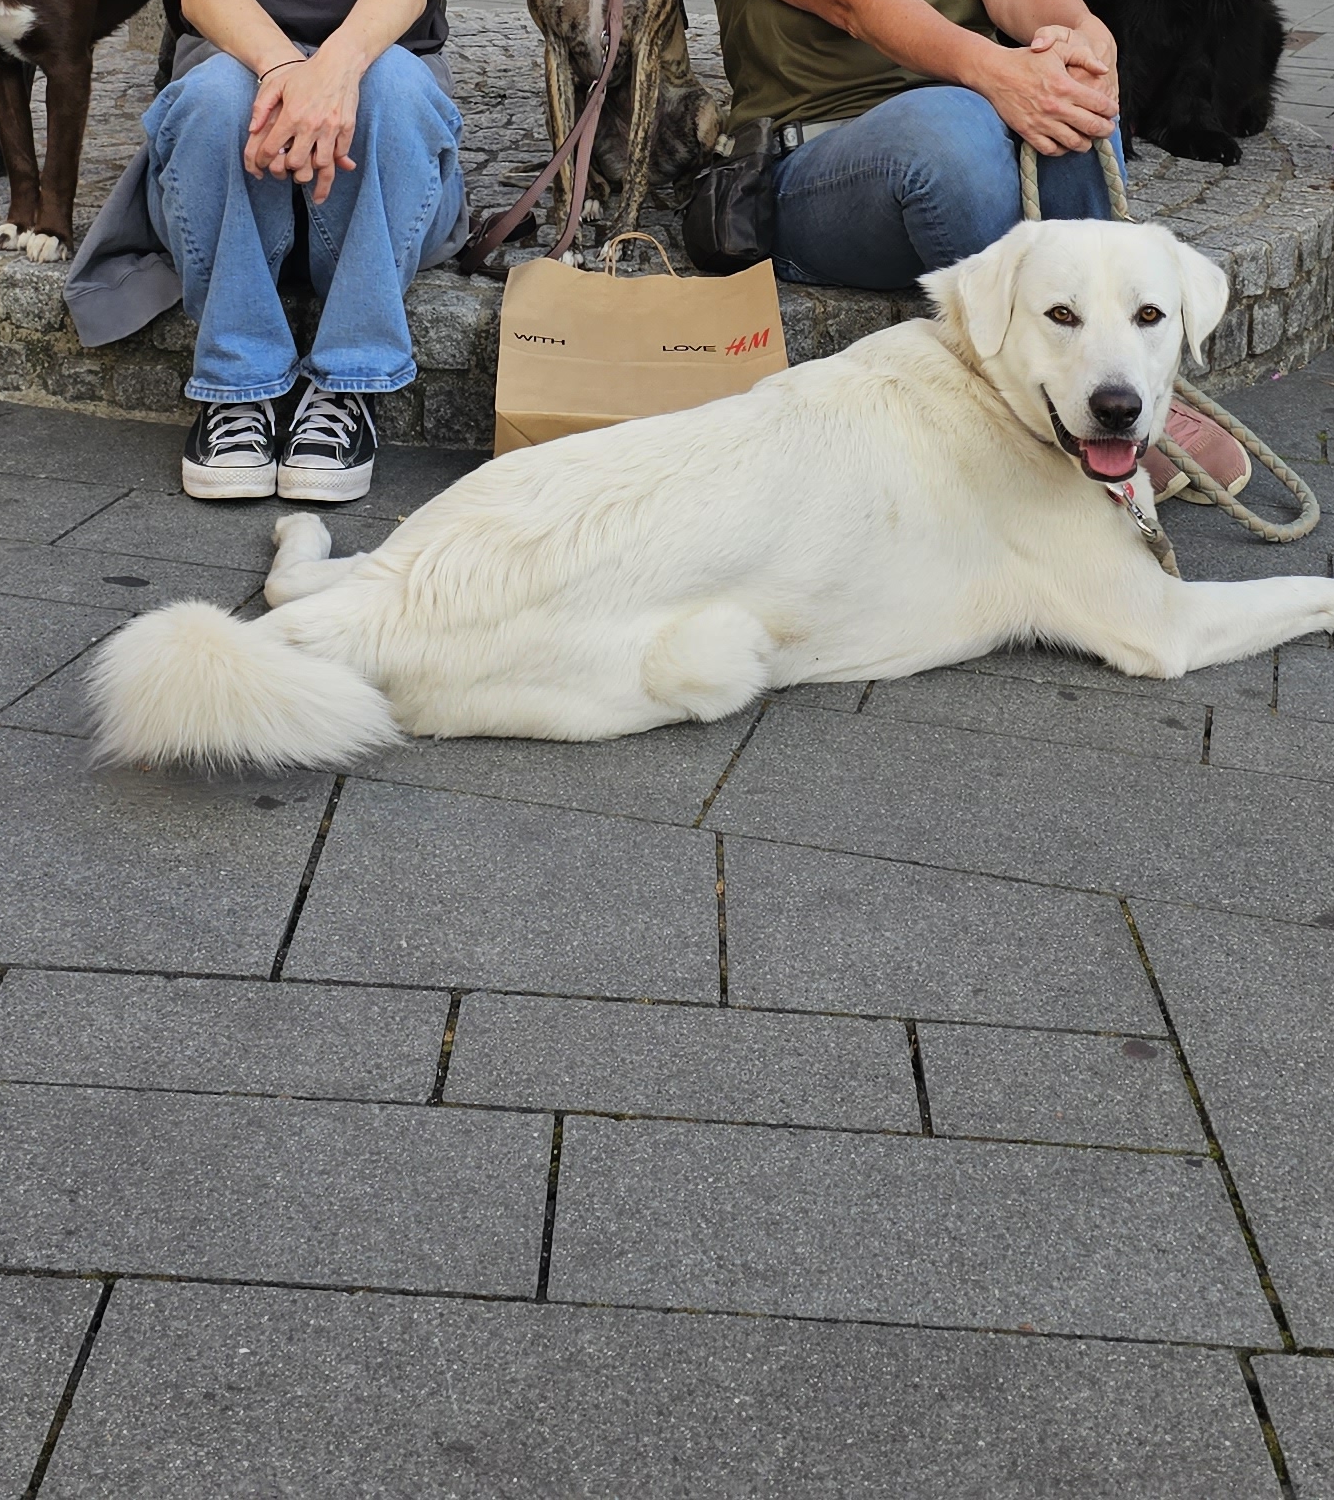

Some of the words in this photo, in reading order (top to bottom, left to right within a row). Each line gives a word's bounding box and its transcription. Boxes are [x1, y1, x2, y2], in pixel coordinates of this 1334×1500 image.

[513, 331, 566, 346] WITH
[662, 344, 717, 352] LOVE
[724, 327, 770, 357] H&M
